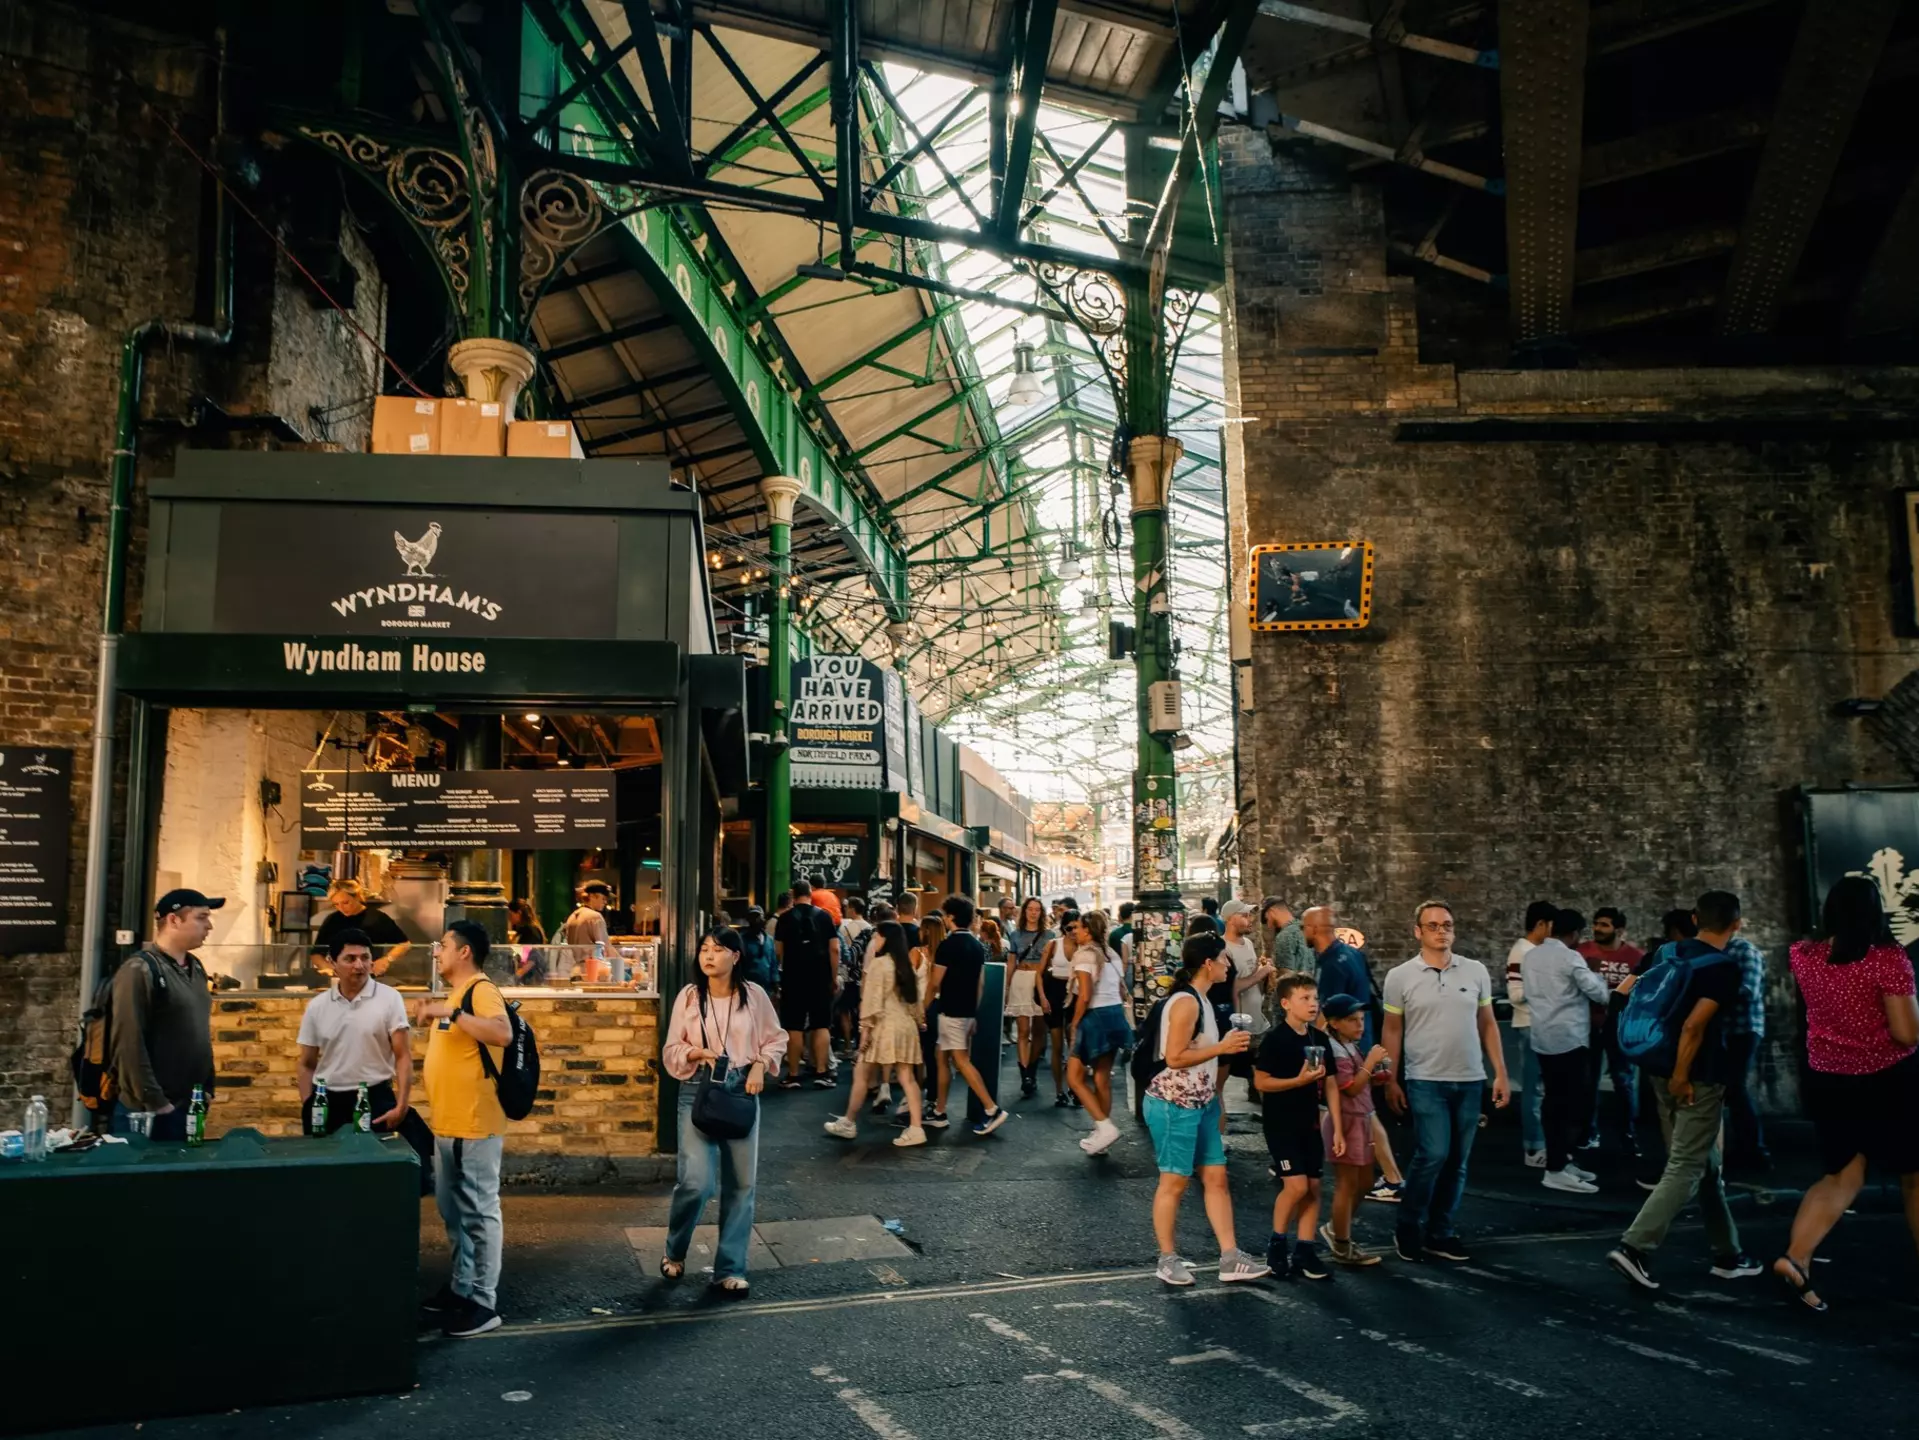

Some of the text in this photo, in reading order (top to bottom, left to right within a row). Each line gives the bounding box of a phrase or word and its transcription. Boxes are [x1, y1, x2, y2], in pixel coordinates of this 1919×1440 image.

[331, 583, 503, 621] WYNDHAM'S
[381, 620, 451, 629] BOROUGH MARKET
[283, 642, 486, 675] Wyndham House
[812, 657, 860, 678] YOU
[804, 679, 868, 699] HAVE
[793, 702, 880, 722] ARRIVED
[797, 728, 873, 742] BOROUGH MARKET
[848, 751, 872, 761] FARM
[392, 774, 441, 787] MENU
[793, 842, 857, 857] SALT BEEF
